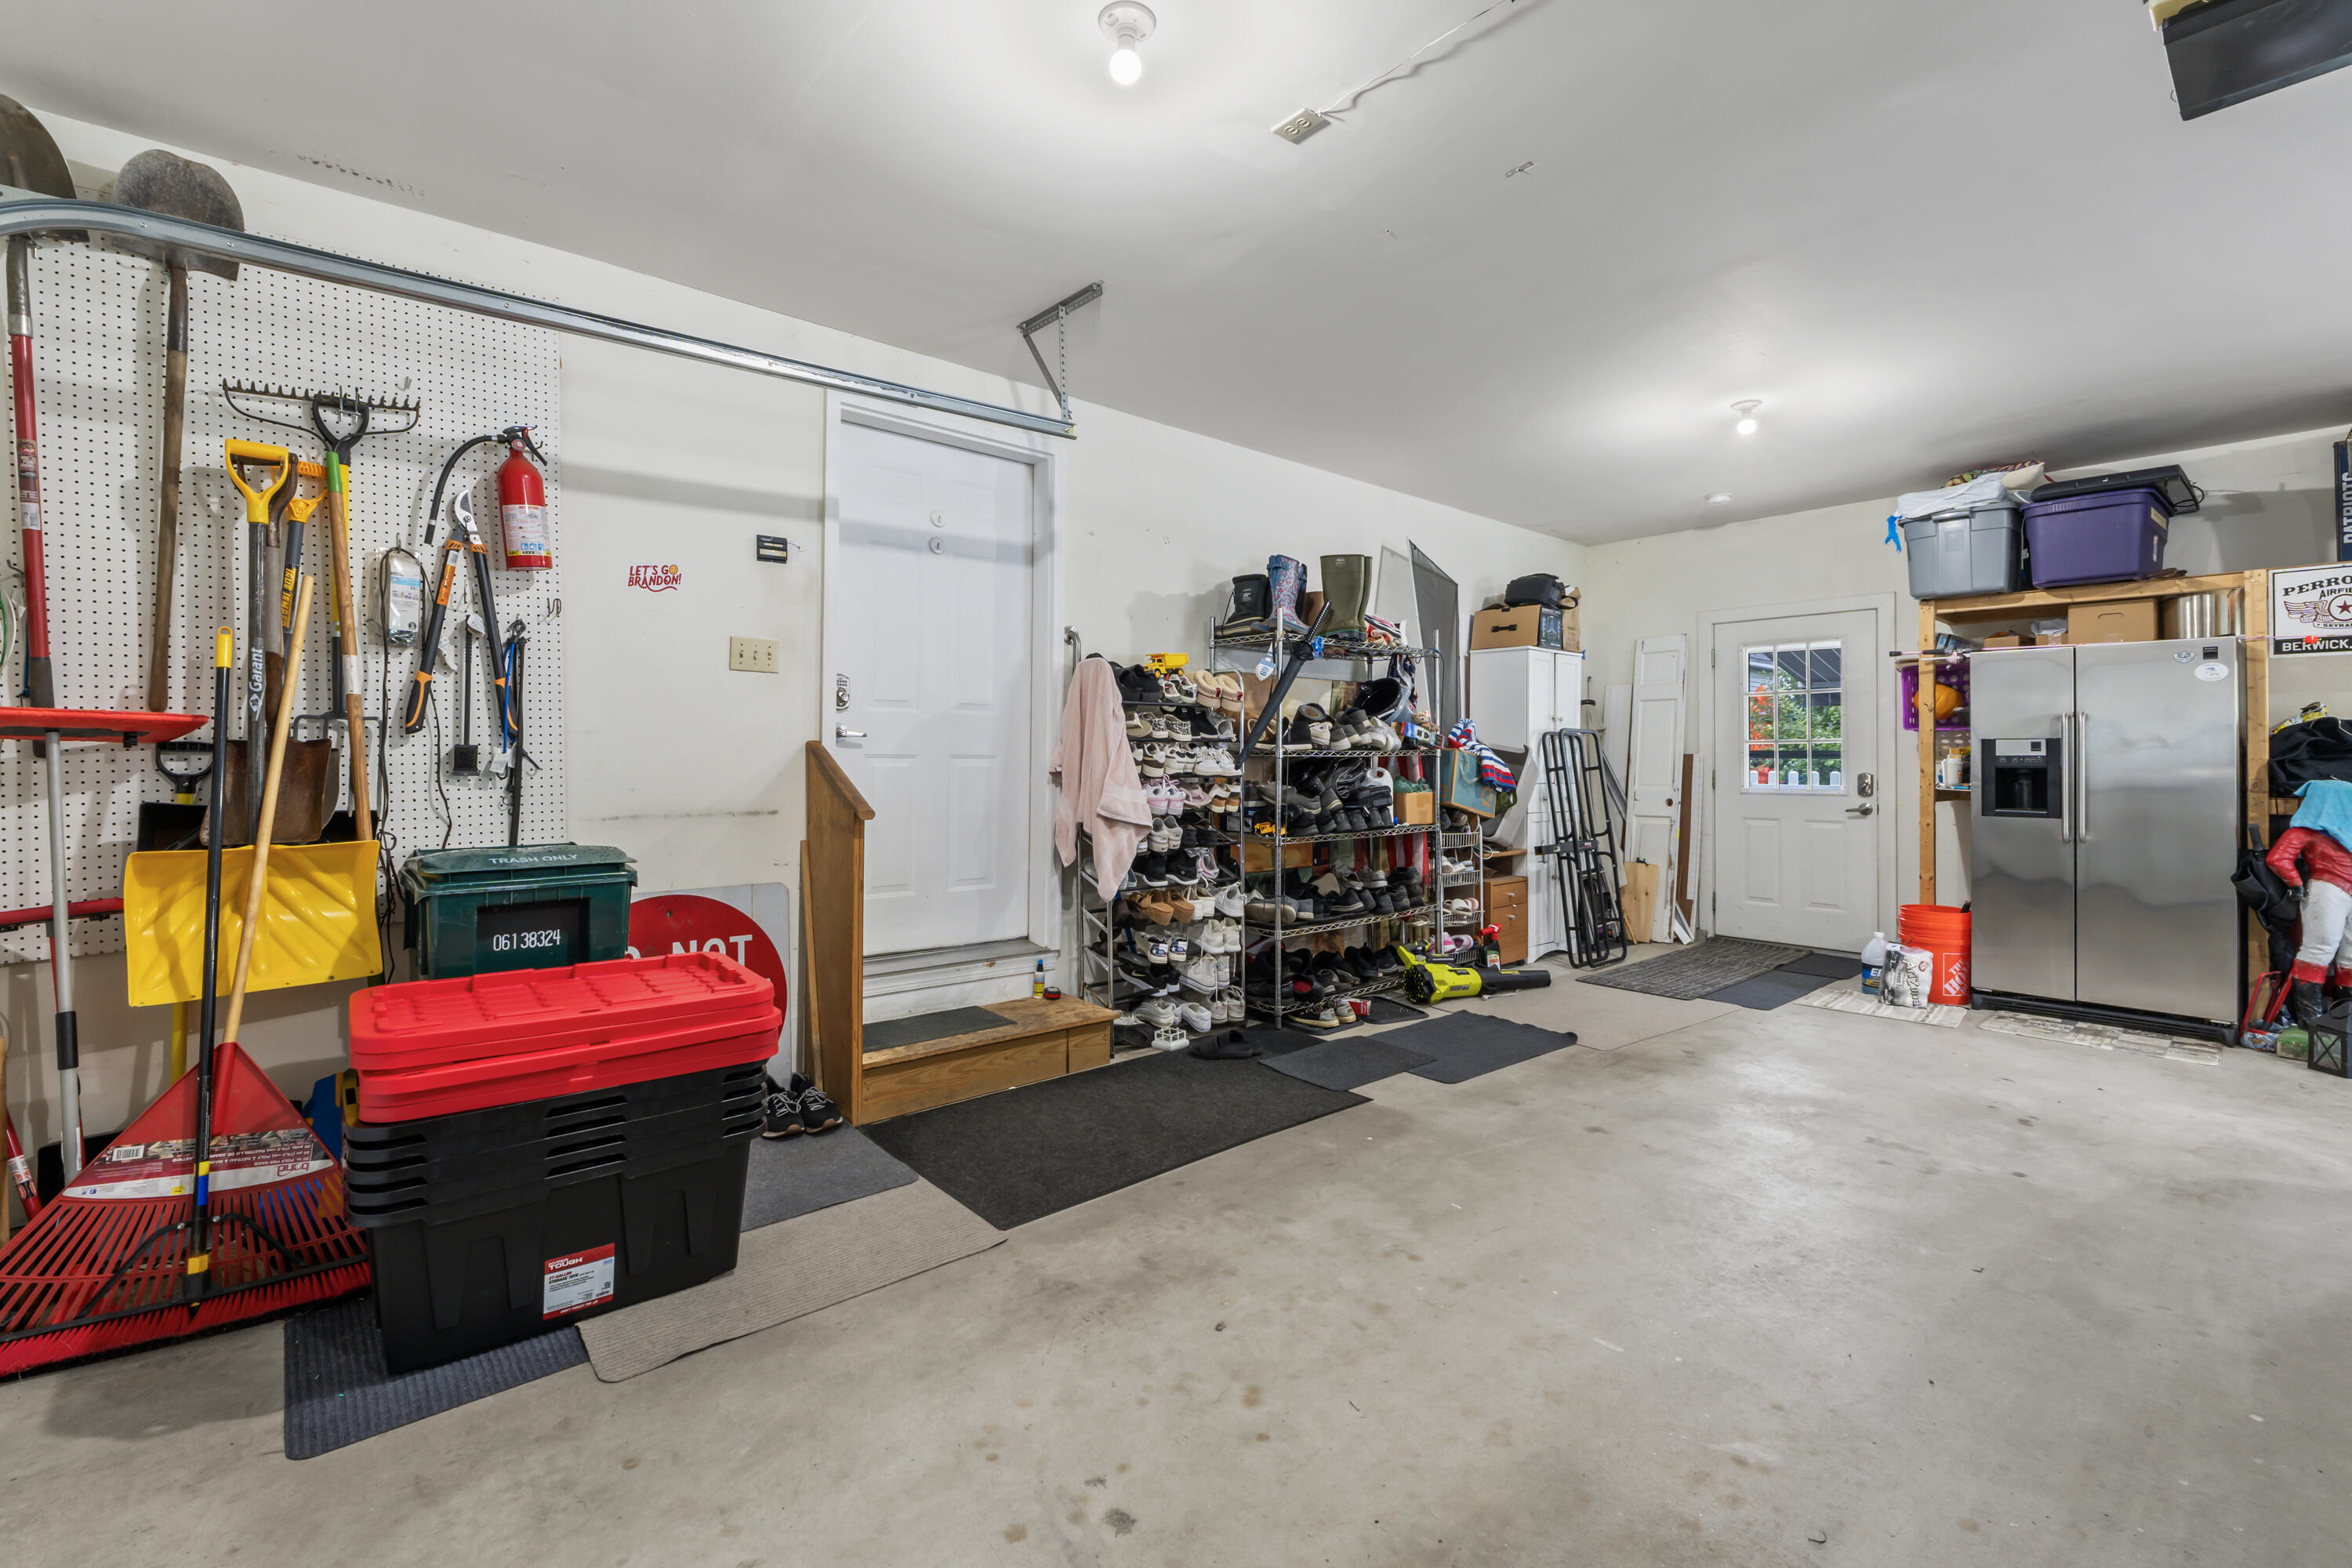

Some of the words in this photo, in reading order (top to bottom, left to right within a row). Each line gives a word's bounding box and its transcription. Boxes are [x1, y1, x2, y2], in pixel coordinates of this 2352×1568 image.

[630, 564, 659, 576] LET'S
[661, 564, 678, 575] GO
[283, 567, 296, 591] TRUE
[627, 573, 682, 592] BRANDON!
[249, 647, 263, 691] Garant
[277, 1162, 310, 1177] bond
[549, 1257, 583, 1270] TOUGH
